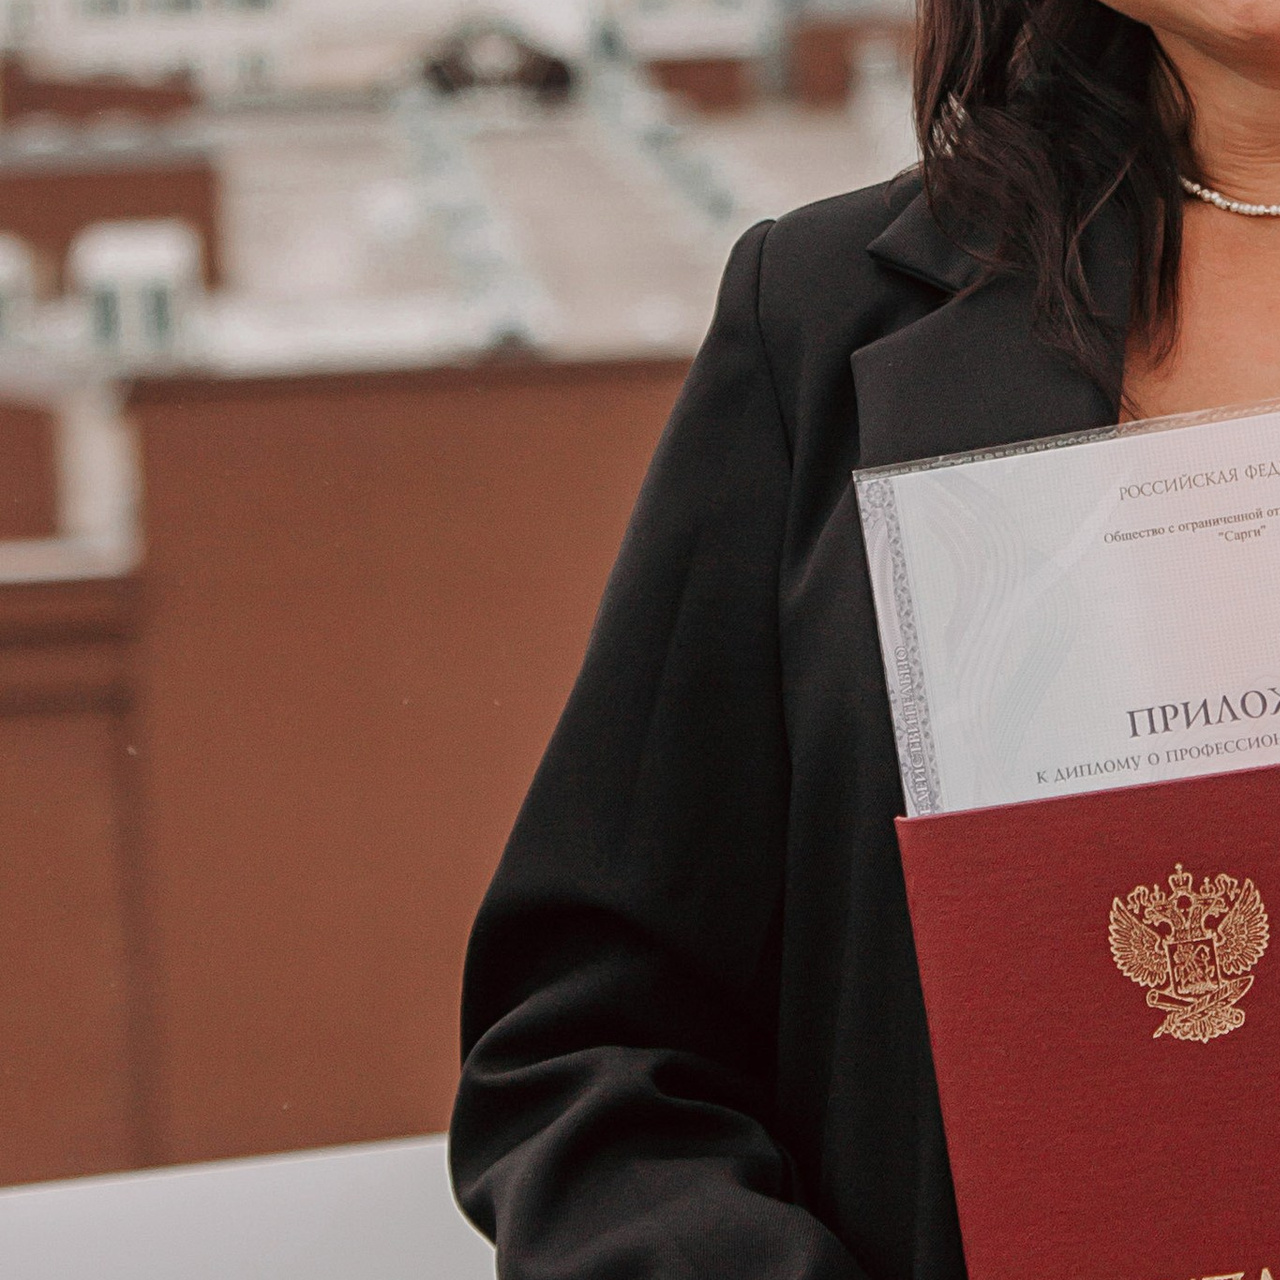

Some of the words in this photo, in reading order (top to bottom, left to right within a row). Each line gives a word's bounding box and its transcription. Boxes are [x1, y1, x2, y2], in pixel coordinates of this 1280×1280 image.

[1119, 468, 1238, 500] РОССИЙСКАЯ
[1104, 526, 1165, 544] Общество
[1168, 524, 1175, 533] с
[1178, 507, 1263, 532] ограниченной
[895, 646, 932, 816] ЕДЕЙСТВИТЕЛЬНО
[1037, 770, 1049, 784] К
[1053, 755, 1141, 784] ДИПЛОМУ
[1147, 752, 1160, 766] О
